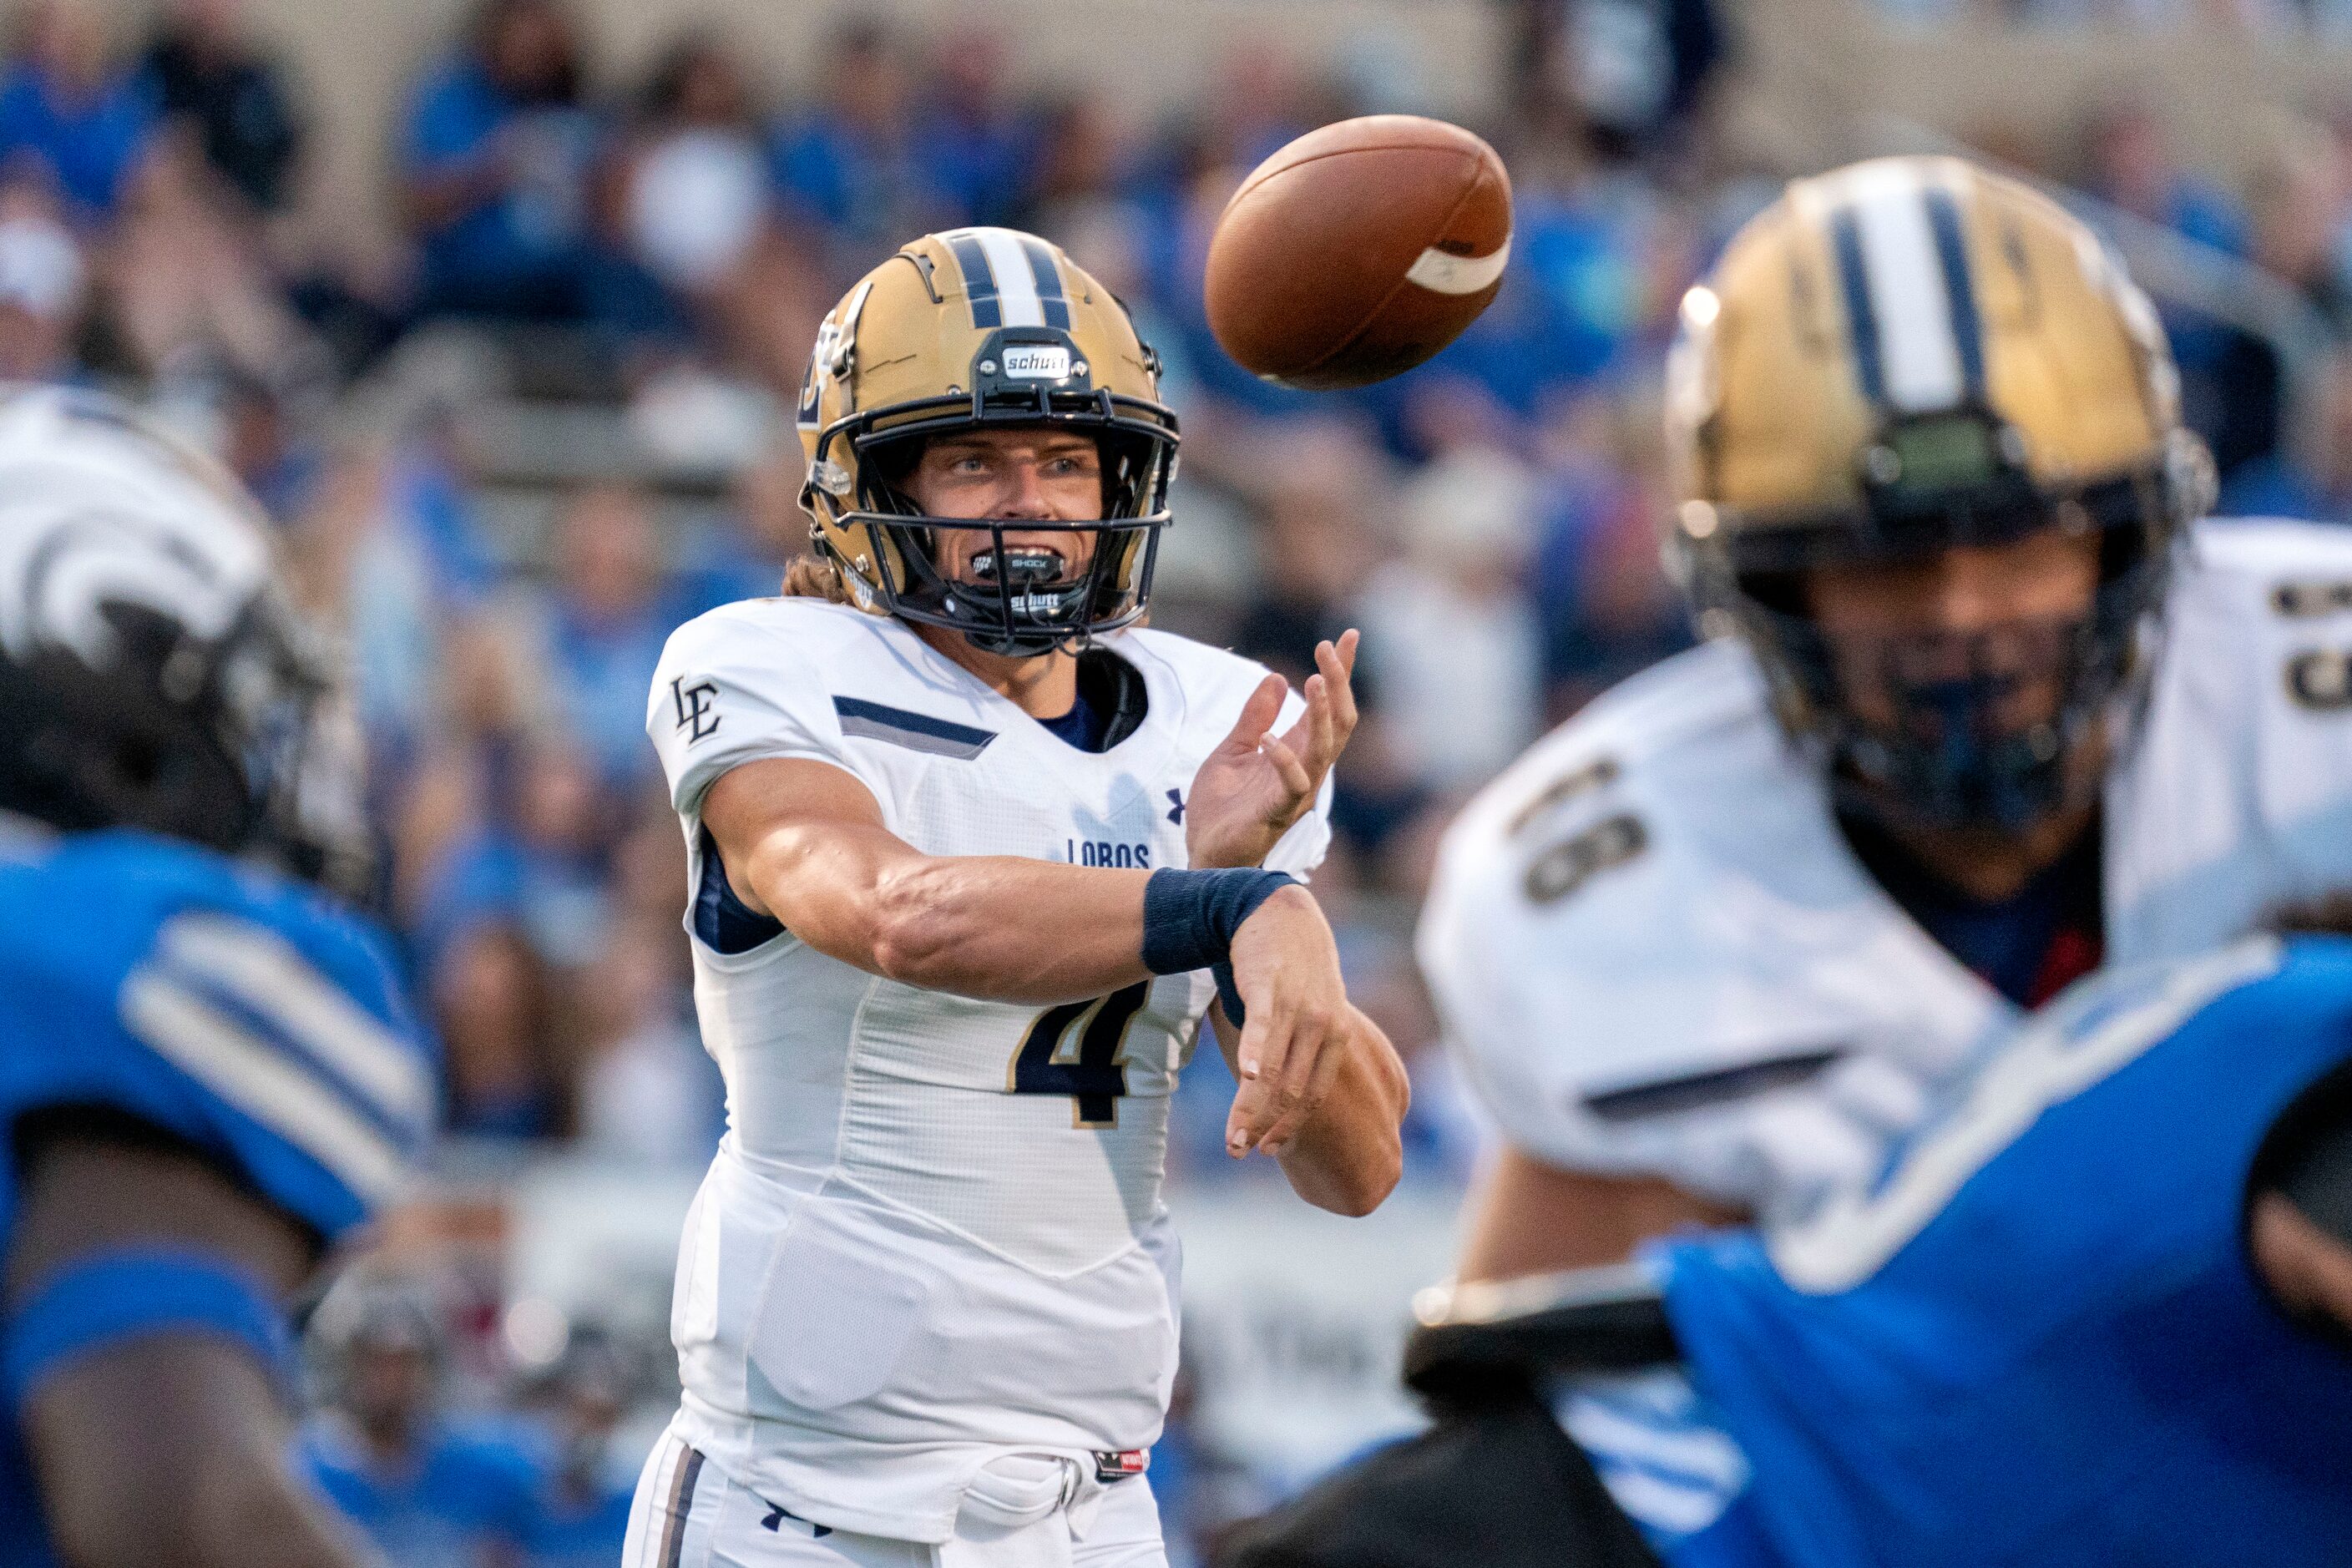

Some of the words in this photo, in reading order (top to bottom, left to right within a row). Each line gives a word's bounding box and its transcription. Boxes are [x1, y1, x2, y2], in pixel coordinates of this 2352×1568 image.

[1011, 559, 1047, 569] SHOCK
[670, 675, 721, 745] LE
[1005, 977, 1153, 1130] 4
